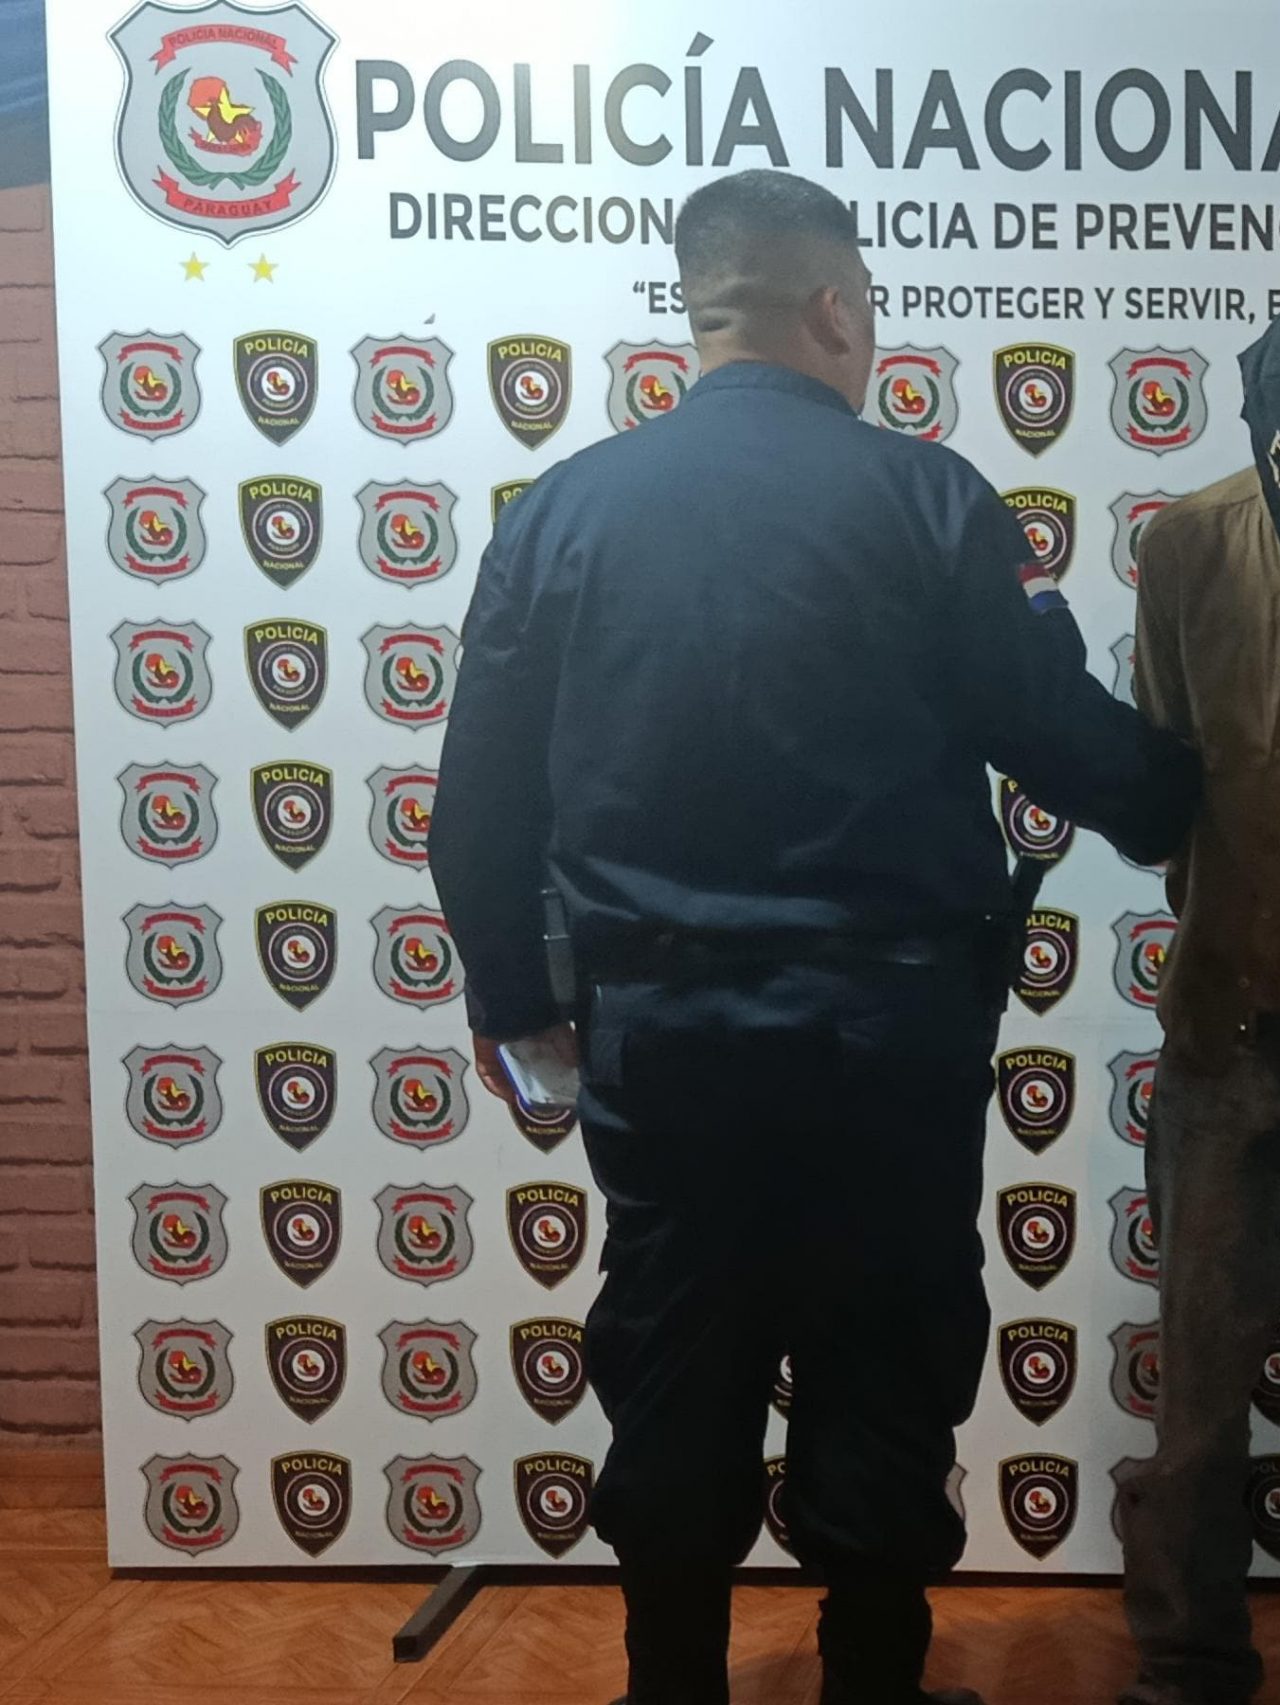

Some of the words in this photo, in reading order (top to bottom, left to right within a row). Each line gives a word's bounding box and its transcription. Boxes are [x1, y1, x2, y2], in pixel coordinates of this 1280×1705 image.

[169, 26, 216, 47] POLICIA
[218, 28, 278, 50] NACIONAL
[356, 32, 790, 167] POLICÍA
[183, 198, 274, 218] PARAGUAY
[390, 195, 673, 245] DIRECCION
[849, 200, 978, 250] LICIA
[995, 203, 1057, 249] DE
[903, 286, 1084, 320] PROTEGER
[1095, 288, 1115, 320] Y
[1126, 287, 1256, 325] SERVIR,
[244, 338, 308, 358] POLICIA
[499, 342, 562, 362] POLICIA
[1003, 350, 1066, 370] POLICIA
[250, 482, 313, 502] POLICIA
[255, 626, 317, 646] POLICIA
[261, 767, 323, 787] POLICIA
[265, 907, 327, 927] POLICIA
[1028, 914, 1070, 932] LICIA
[266, 1049, 326, 1068] POLICIA
[1006, 1053, 1066, 1071] POLICIA
[271, 1186, 331, 1205] POLICIA
[517, 1188, 577, 1207] POLICIA
[1007, 1189, 1067, 1207] POLICIA
[276, 1322, 336, 1341] POLICIA
[521, 1324, 581, 1343] POLICIA
[1008, 1324, 1068, 1342] POLICIA
[282, 1457, 342, 1476] POLICIA
[525, 1458, 584, 1477] POLICIA
[1009, 1459, 1069, 1477] POLICIA
